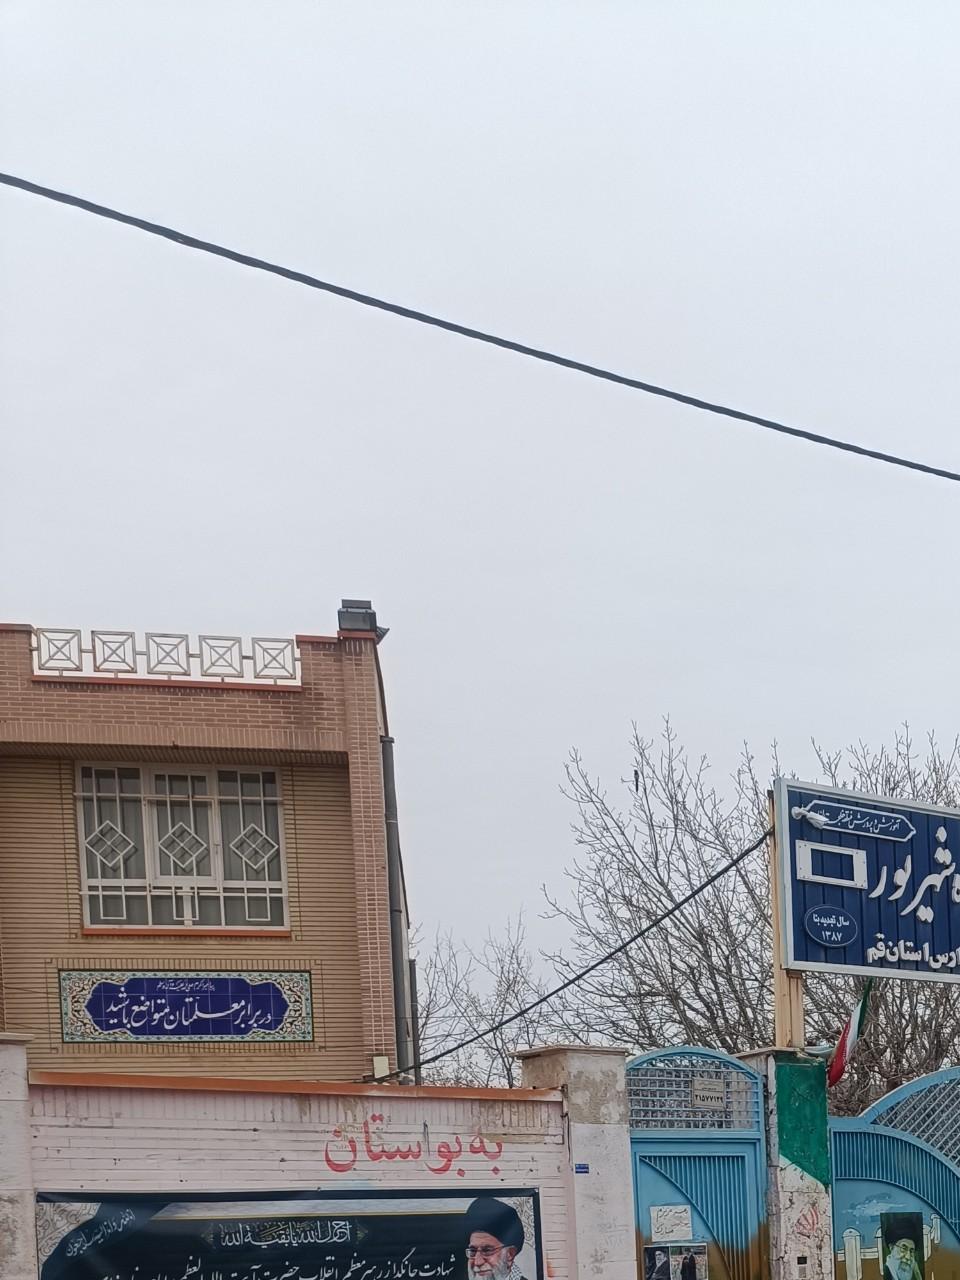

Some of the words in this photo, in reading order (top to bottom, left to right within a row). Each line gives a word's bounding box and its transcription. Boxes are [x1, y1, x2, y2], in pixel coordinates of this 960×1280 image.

[874, 817, 901, 832] آموزش
[868, 826, 956, 923] شهریور
[812, 913, 820, 926] بنا
[820, 914, 837, 927] تجدید
[836, 915, 850, 927] سال
[821, 930, 842, 942] ۱۳۸۷
[866, 932, 886, 963] قم
[885, 939, 930, 962] استان
[106, 986, 131, 1028] باشید
[131, 996, 170, 1027] متواضع
[233, 1003, 261, 1027] برابر
[259, 1012, 272, 1024] در
[469, 1127, 503, 1175] به
[418, 1253, 456, 1277] شهادت
